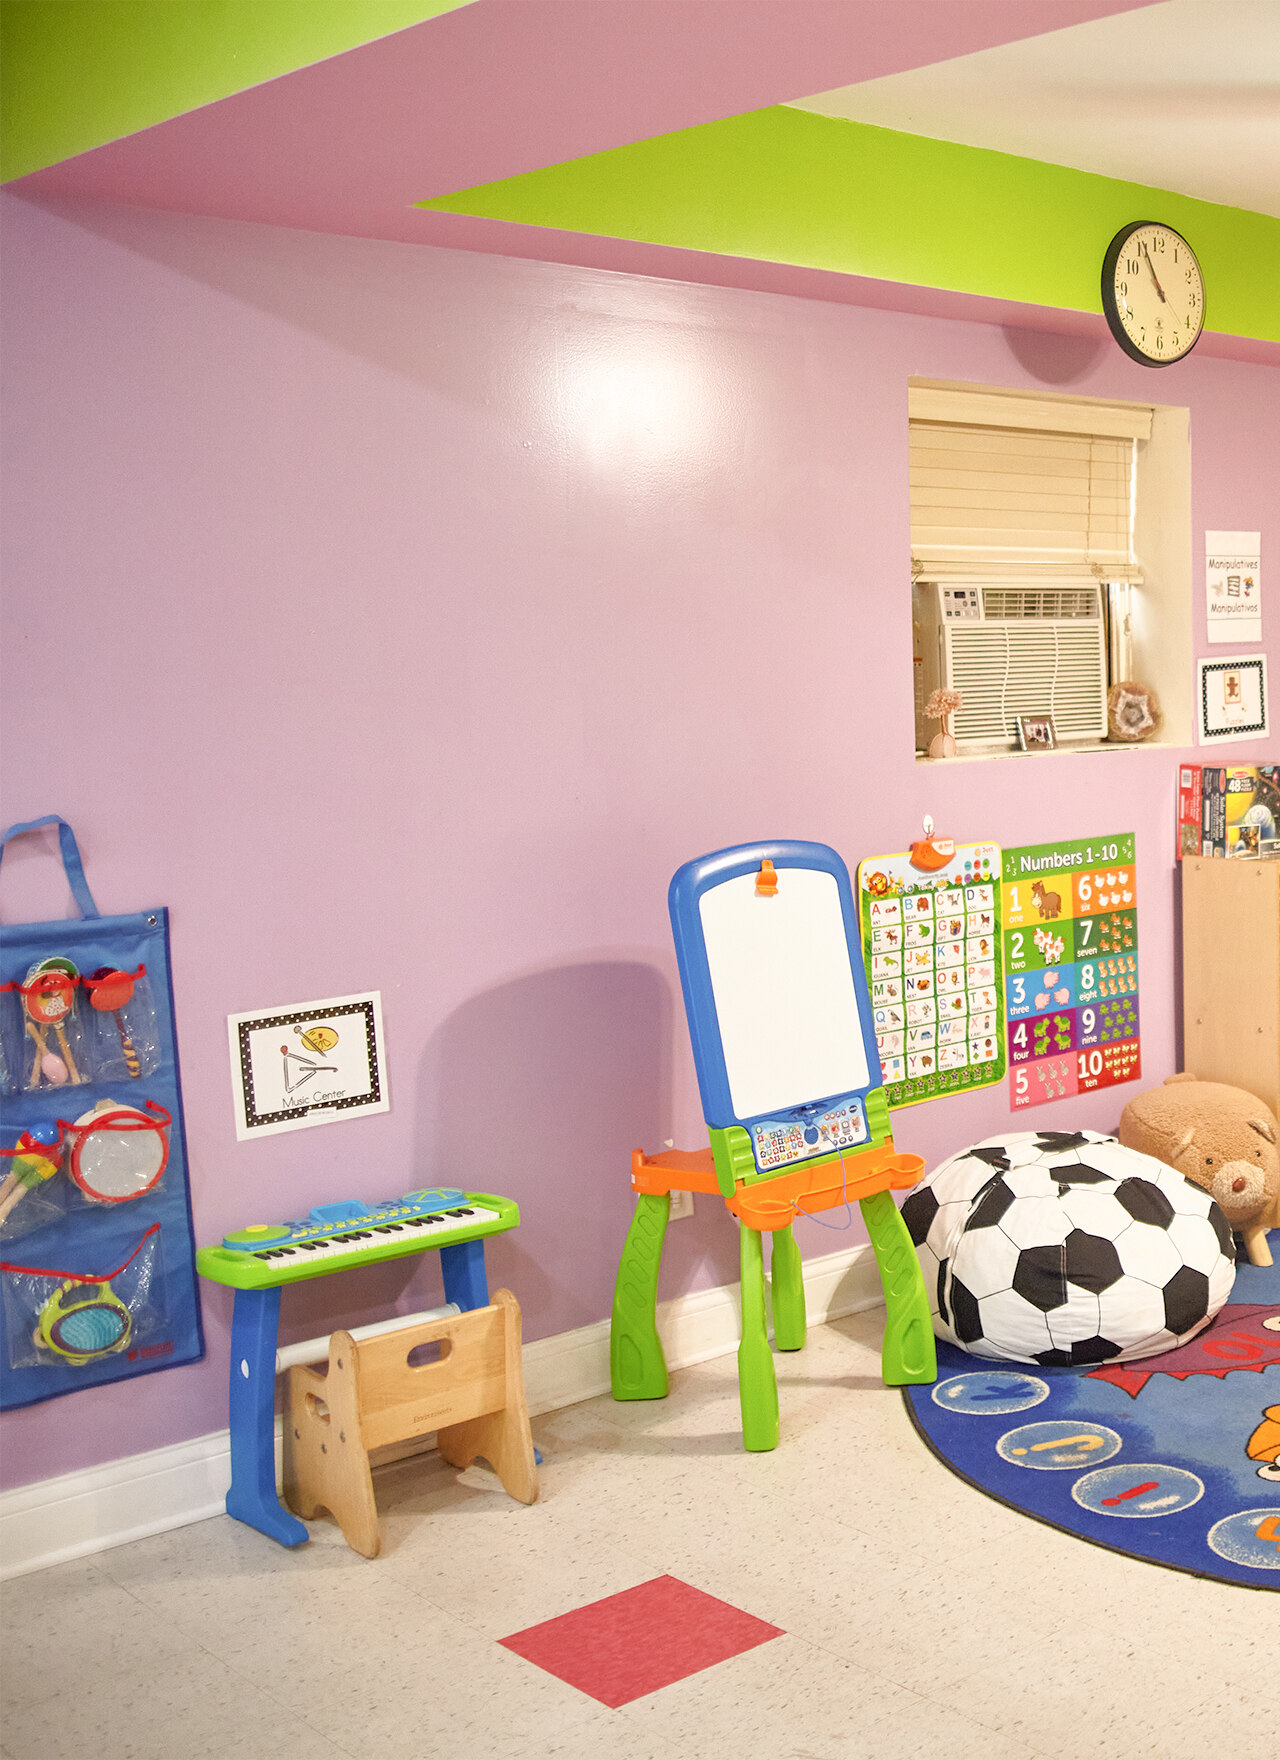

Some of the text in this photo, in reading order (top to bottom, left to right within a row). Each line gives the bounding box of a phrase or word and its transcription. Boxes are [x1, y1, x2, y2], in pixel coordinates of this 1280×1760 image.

[1138, 242, 1148, 257] 11
[1153, 237, 1165, 253] 12
[1174, 249, 1178, 264] 1
[1126, 259, 1139, 276] 10
[1185, 270, 1192, 284] 2
[1120, 282, 1128, 296] 9
[1188, 293, 1196, 308] 3
[1126, 306, 1134, 320] 8
[1184, 315, 1190, 328] 4
[1140, 326, 1146, 342] 7
[1172, 332, 1178, 346] 5
[1156, 335, 1163, 350] 6
[1208, 558, 1258, 571] Manipulatives
[1228, 780, 1241, 792] 48
[1020, 852, 1083, 873] Numbers
[1078, 876, 1092, 901] 6
[936, 894, 944, 905] C
[966, 890, 974, 900] D
[1010, 886, 1022, 912] 1
[872, 904, 881, 916] A
[904, 899, 913, 910] B
[1080, 902, 1091, 912] six
[968, 915, 976, 926] H
[1008, 914, 1024, 924] one
[906, 925, 913, 936] F
[938, 920, 947, 931] G
[873, 930, 882, 942] E
[1080, 920, 1093, 946] 7
[938, 946, 945, 956] K
[968, 941, 974, 952] L
[1011, 932, 1024, 958] 2
[906, 952, 912, 963] J
[1076, 947, 1098, 958] seven
[1010, 960, 1026, 970] two
[938, 973, 946, 984] O
[968, 967, 976, 978] P
[1081, 964, 1094, 990] 8
[874, 984, 884, 996] M
[906, 978, 914, 990] N
[1012, 978, 1026, 1004] 3
[1079, 990, 1098, 1002] eight
[970, 992, 977, 1003] T
[908, 1005, 917, 1016] R
[940, 999, 947, 1010] S
[1010, 1005, 1030, 1016] three
[876, 1011, 886, 1022] Q
[971, 1017, 978, 1028] X
[1082, 1008, 1096, 1034] 9
[940, 1023, 951, 1034] W
[909, 1030, 918, 1041] V
[1013, 1023, 1028, 1049] 4
[1081, 1034, 1098, 1045] nine
[940, 1050, 948, 1060] Z
[1013, 1050, 1030, 1061] four
[909, 1056, 917, 1067] Y
[1078, 1050, 1103, 1079] 10
[1016, 1068, 1028, 1094] 5
[1084, 1078, 1098, 1088] ten
[282, 1089, 346, 1108] Music Center
[1016, 1095, 1030, 1106] five
